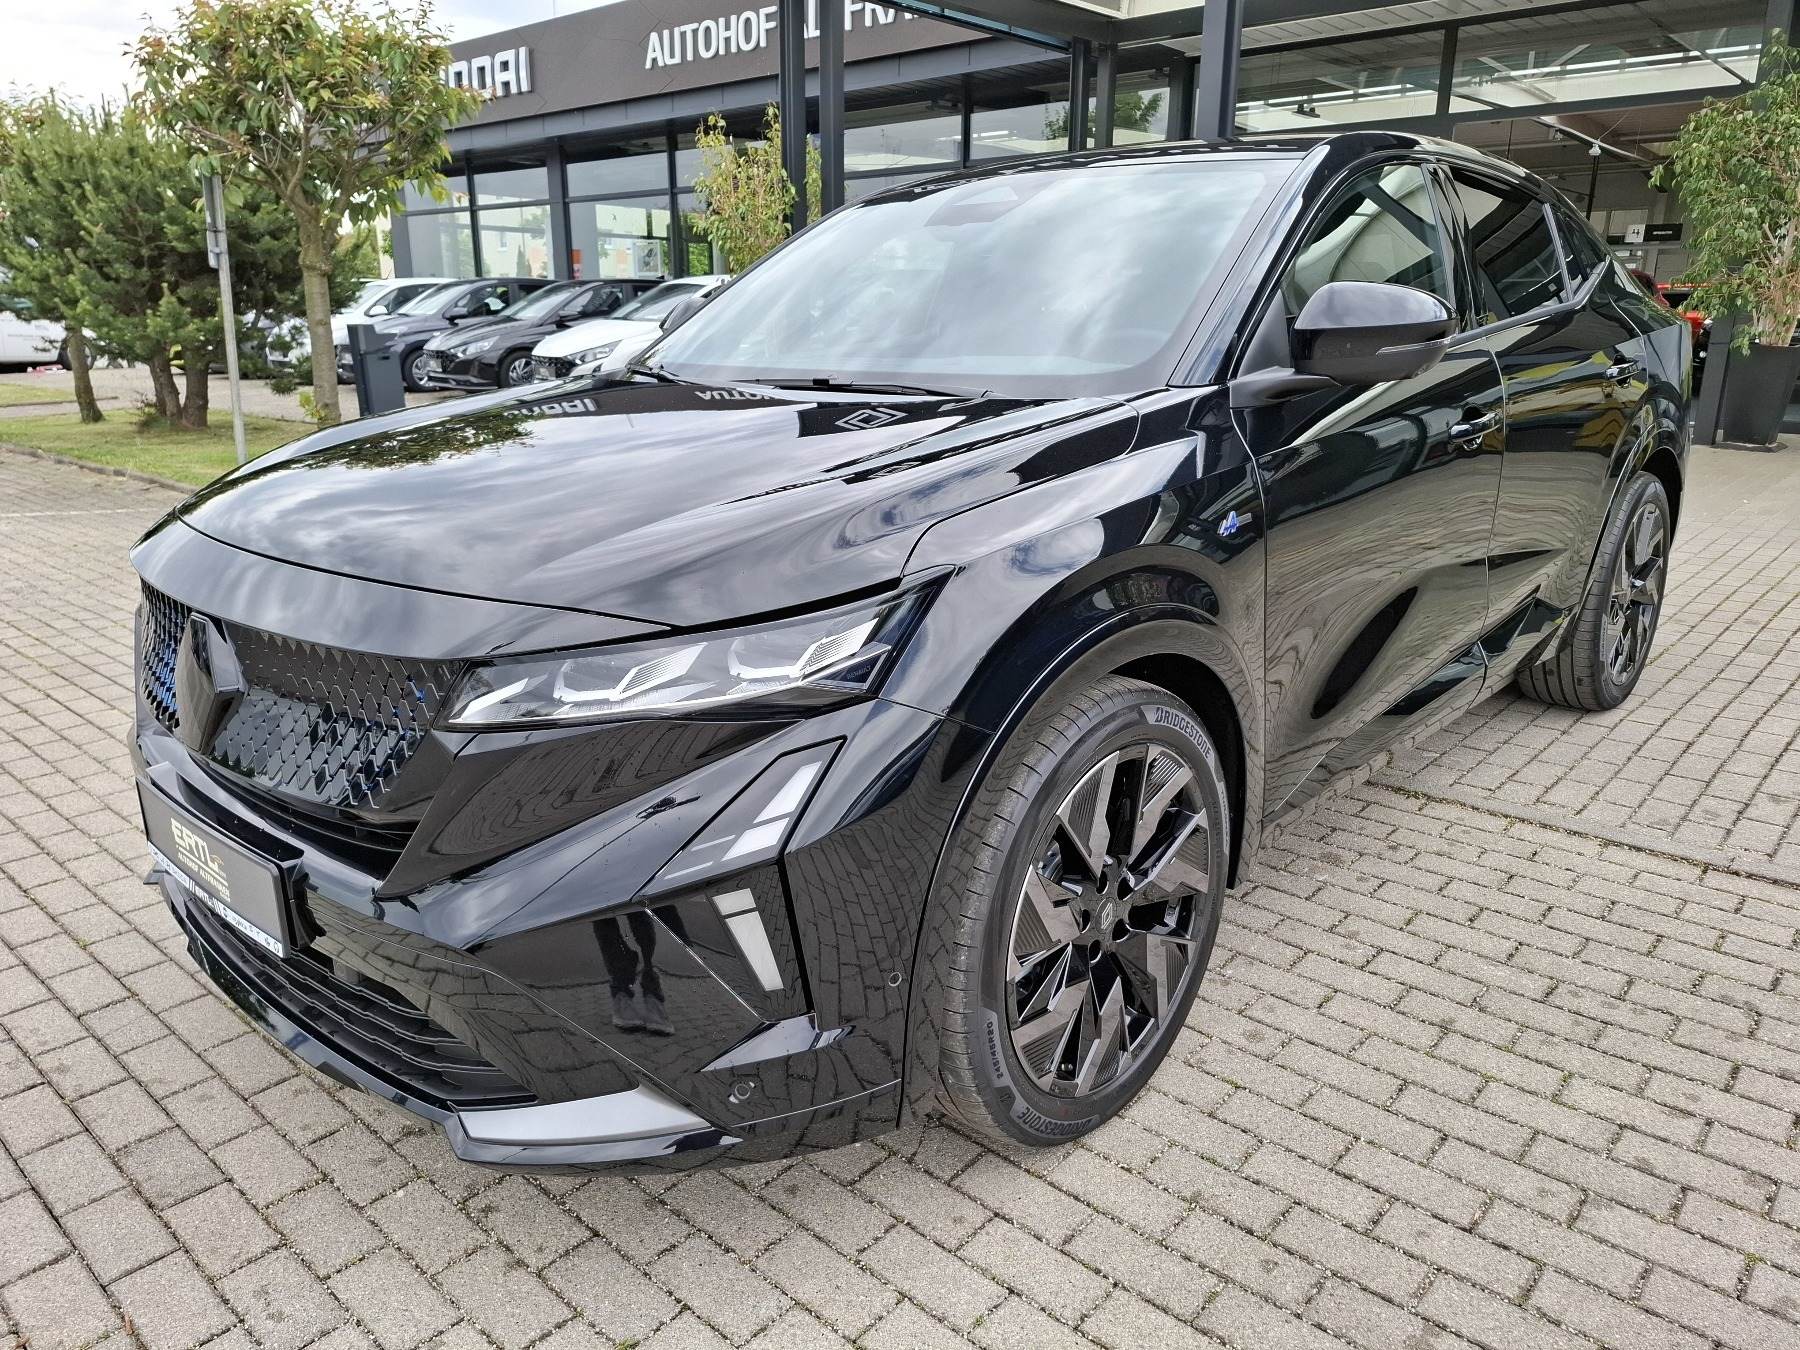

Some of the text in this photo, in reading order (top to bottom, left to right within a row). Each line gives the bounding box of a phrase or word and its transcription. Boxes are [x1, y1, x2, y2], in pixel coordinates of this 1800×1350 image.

[645, 6, 778, 69] AUTOHOF
[440, 46, 532, 98] NDAI
[1154, 706, 1212, 759] BRIDGESTONE
